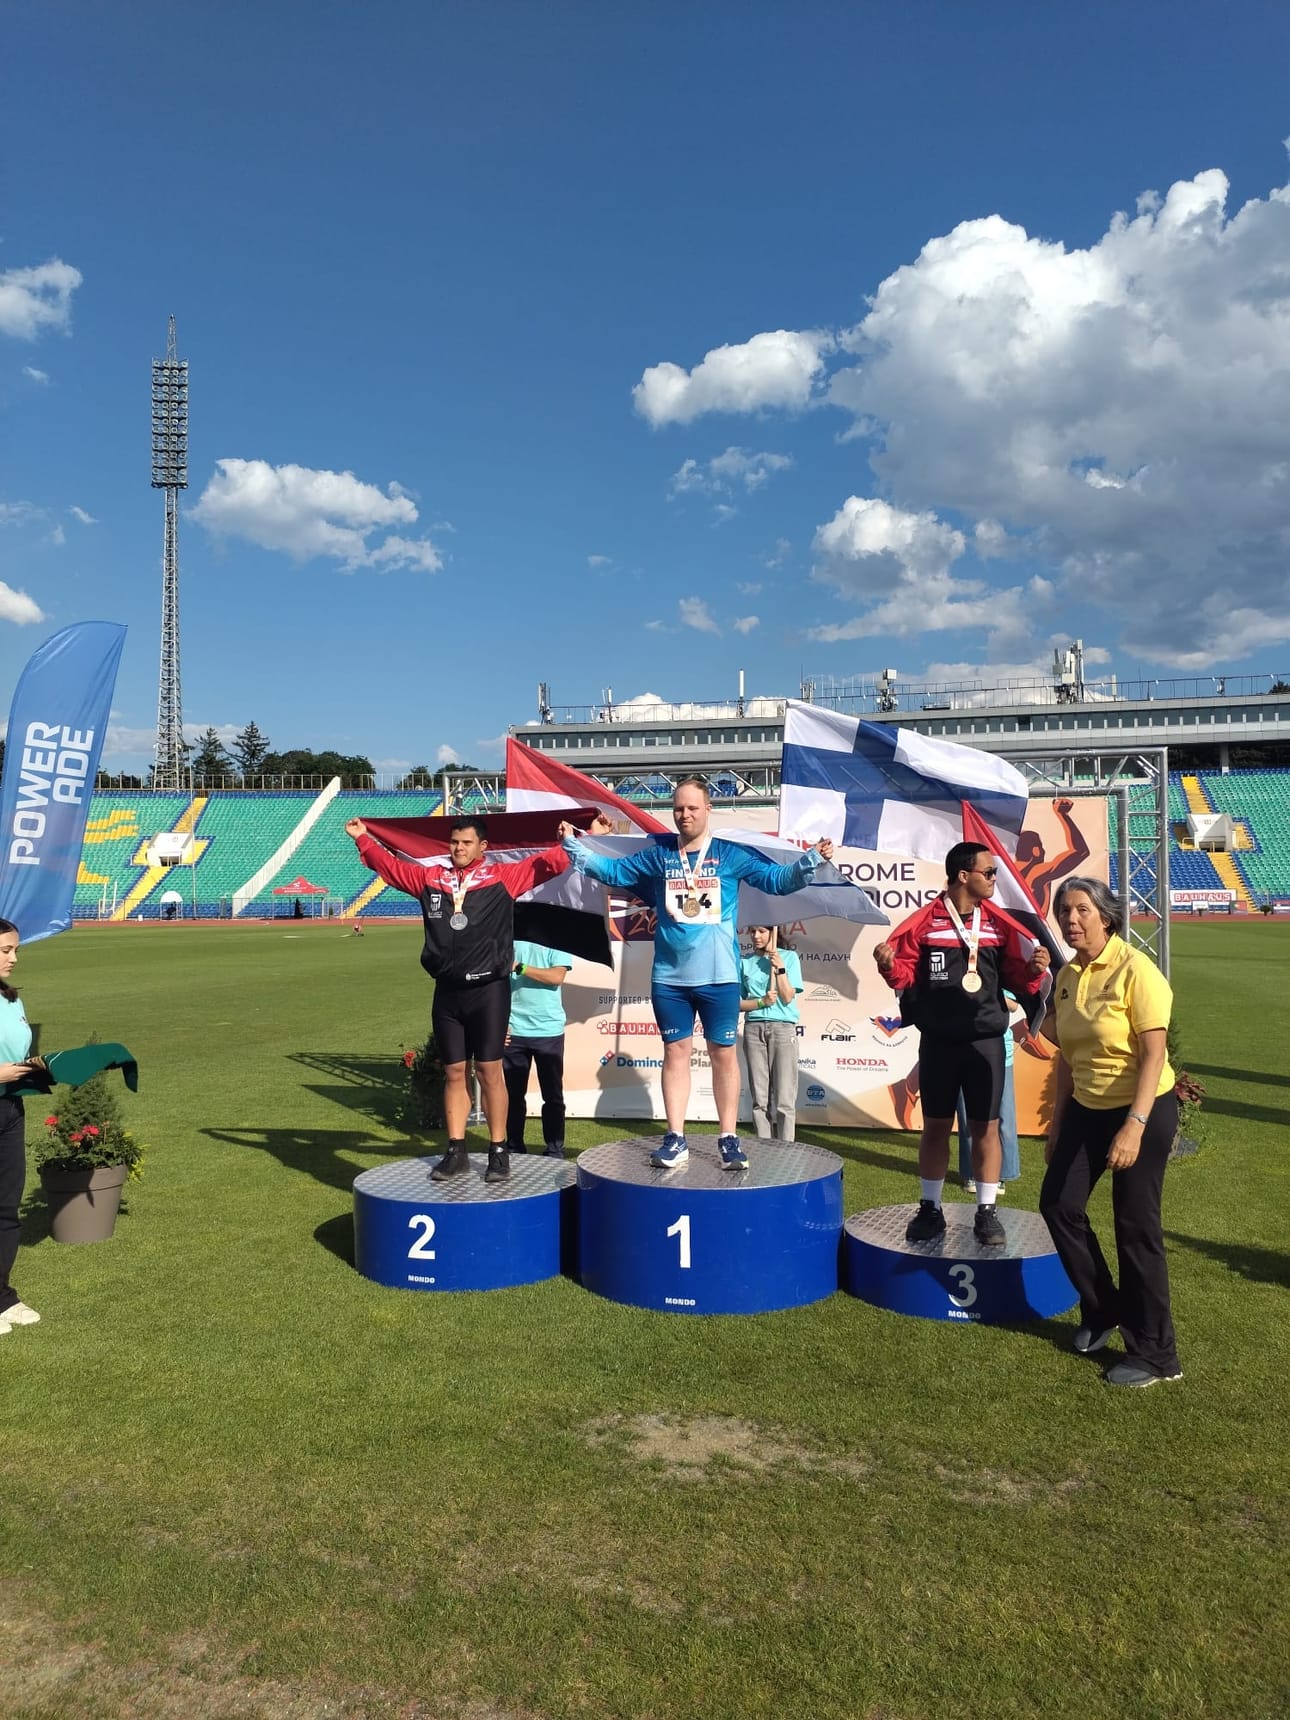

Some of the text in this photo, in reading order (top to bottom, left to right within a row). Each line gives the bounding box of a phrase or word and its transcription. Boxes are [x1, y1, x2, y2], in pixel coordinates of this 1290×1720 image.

[52, 726, 94, 804] ADE
[9, 722, 61, 865] POWER
[665, 868, 716, 878] FINND
[675, 893, 712, 909] 14
[1174, 892, 1231, 902] BAUHAUS
[836, 1058, 888, 1066] HONDA
[407, 1215, 435, 1259] 2
[667, 1215, 691, 1268] 1
[408, 1275, 435, 1284] MONDO
[948, 1264, 977, 1307] 3
[665, 1297, 695, 1306] MONDO
[948, 1310, 981, 1319] MONDO
